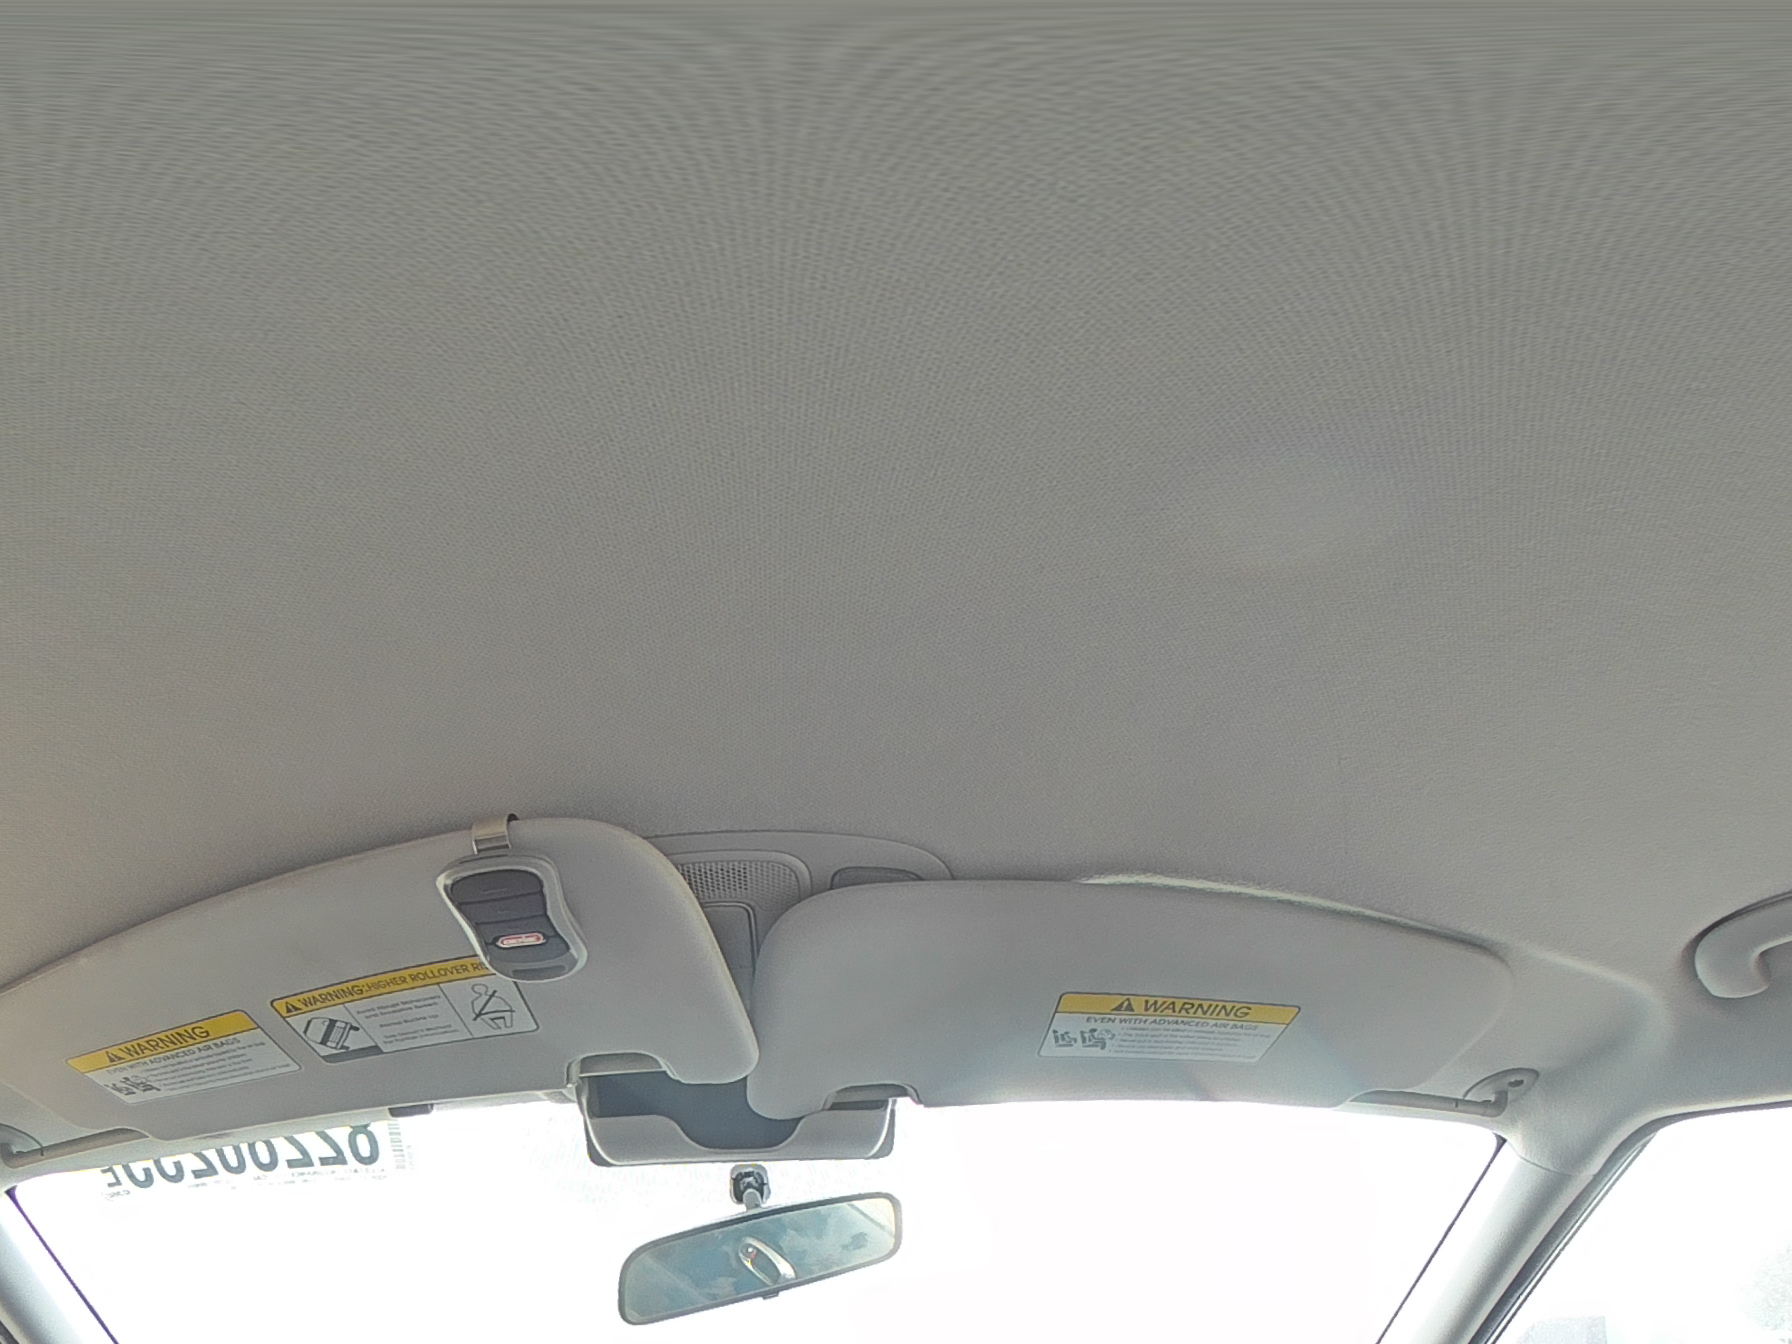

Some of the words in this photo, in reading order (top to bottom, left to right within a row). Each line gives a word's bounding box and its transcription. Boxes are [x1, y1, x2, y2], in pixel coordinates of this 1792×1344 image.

[367, 976, 408, 993] HIGHER
[408, 964, 470, 981] ROLLOVER
[1142, 998, 1252, 1019] WARNING
[1085, 1016, 1117, 1024] EVEN
[1119, 1017, 1149, 1025] WITH
[1151, 1018, 1210, 1028] ADVANCED
[1211, 1021, 1230, 1029] AIR
[1232, 1022, 1260, 1031] BAGS
[120, 1025, 211, 1058] WARNING
[128, 1059, 149, 1071] WITH
[149, 1048, 196, 1066] ADVANCED
[197, 1043, 213, 1054] AIR
[213, 1036, 241, 1049] BAGS
